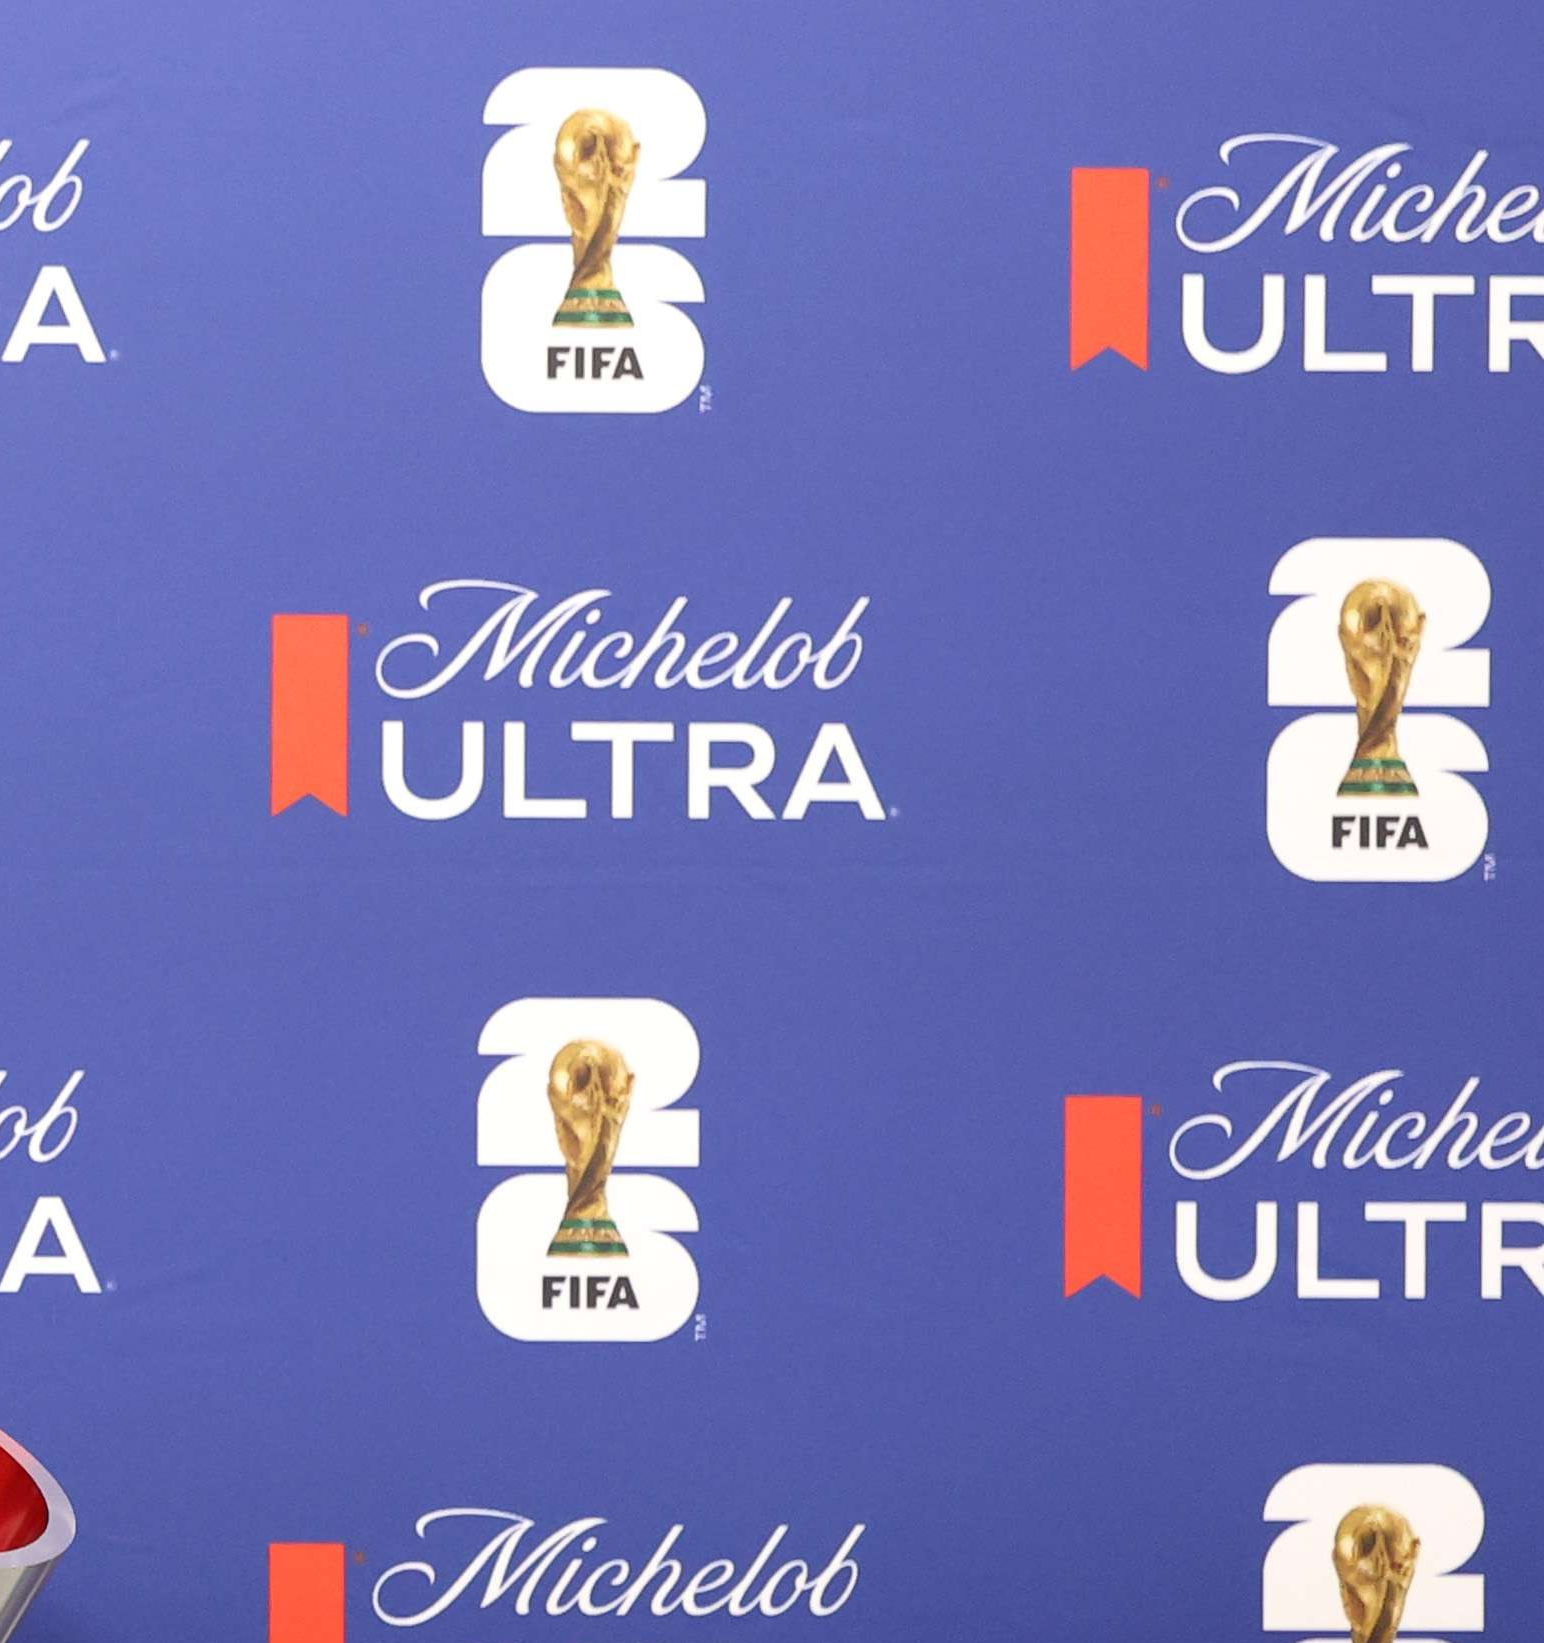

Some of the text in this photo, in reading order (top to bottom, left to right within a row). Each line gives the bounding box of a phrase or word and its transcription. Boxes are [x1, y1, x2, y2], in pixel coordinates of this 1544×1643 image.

[1174, 132, 1544, 254] Miche
[546, 346, 644, 380] FIFA
[374, 578, 871, 700] Michelob
[381, 719, 887, 822] ULTRA
[1331, 815, 1429, 849] FIFA
[1168, 1059, 1544, 1181] Miche
[541, 1275, 640, 1310] FIFA
[371, 1506, 867, 1628] Michelob
